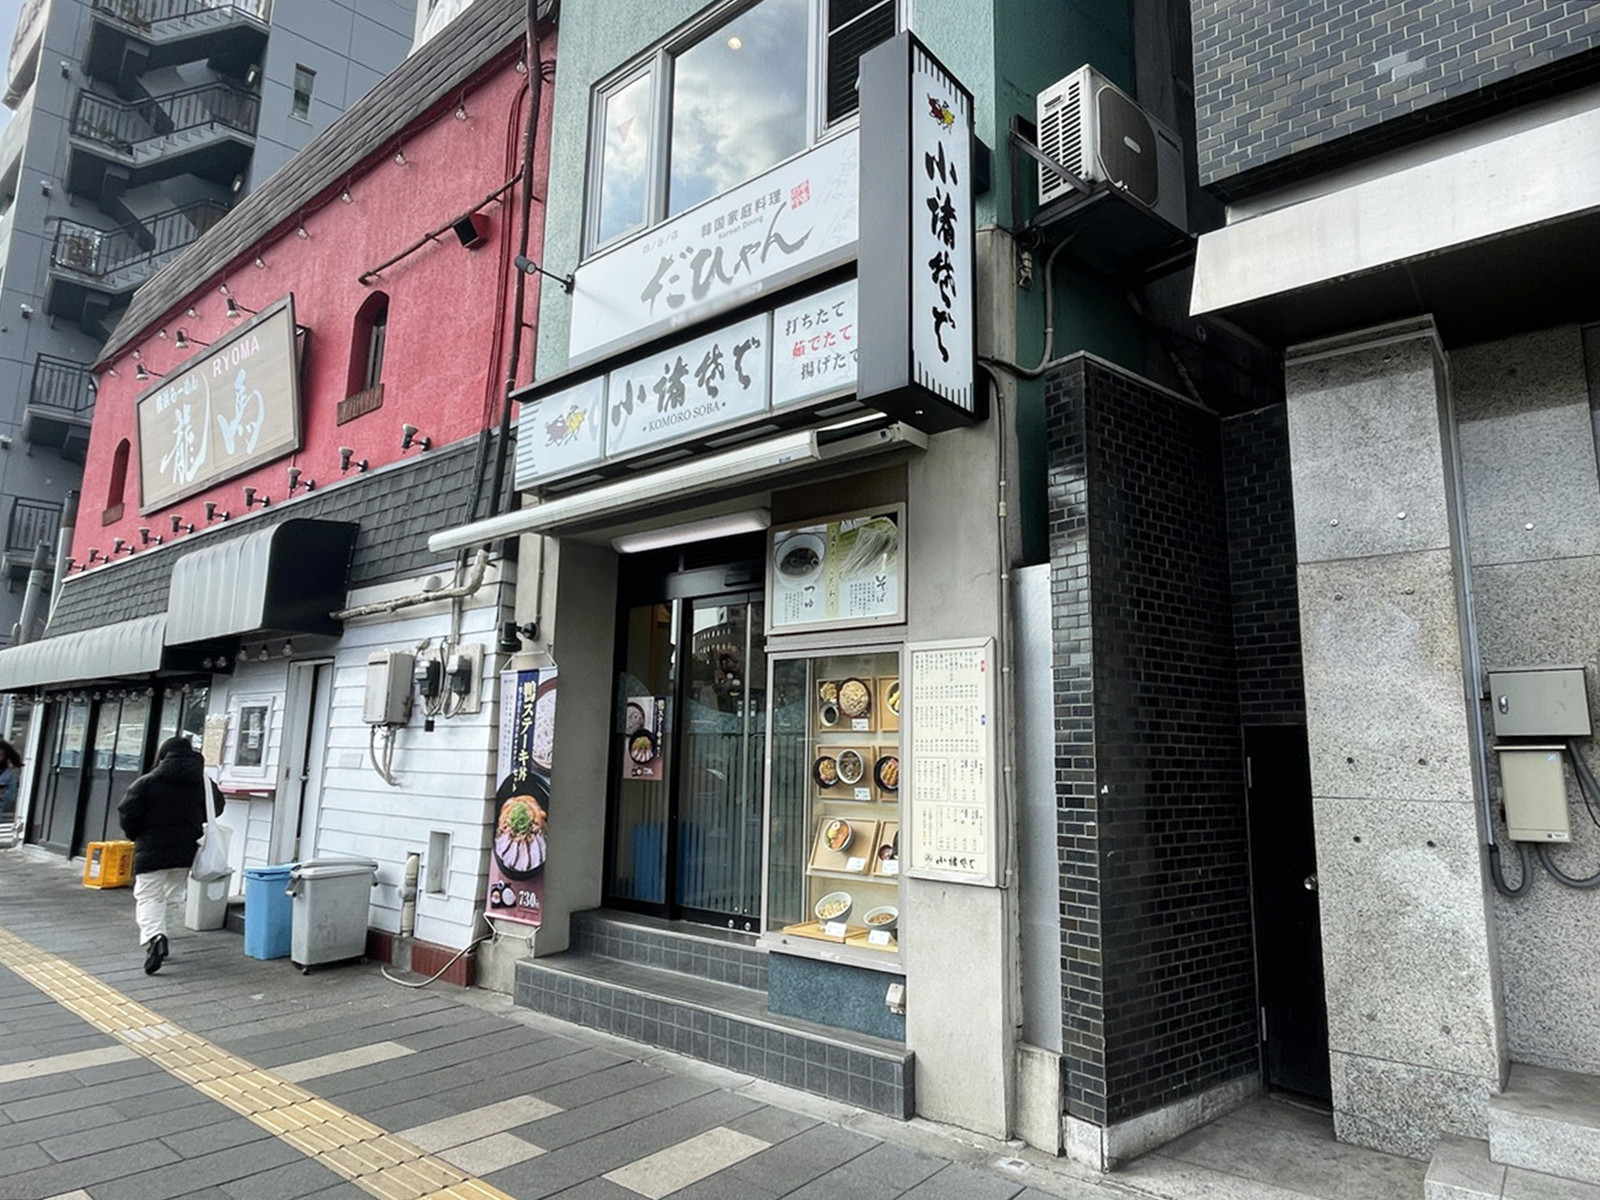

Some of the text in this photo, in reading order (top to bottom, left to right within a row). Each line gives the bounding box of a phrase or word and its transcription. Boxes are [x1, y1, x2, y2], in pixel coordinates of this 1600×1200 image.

[701, 188, 782, 238] 韓国家庭料理
[640, 201, 814, 320] だひゃん
[785, 301, 845, 336] 打ちたて
[212, 335, 260, 378] RYOMA
[792, 324, 853, 358] 茹でたて
[160, 369, 265, 485] 龍馬
[648, 401, 720, 432] KOMORO SOBA
